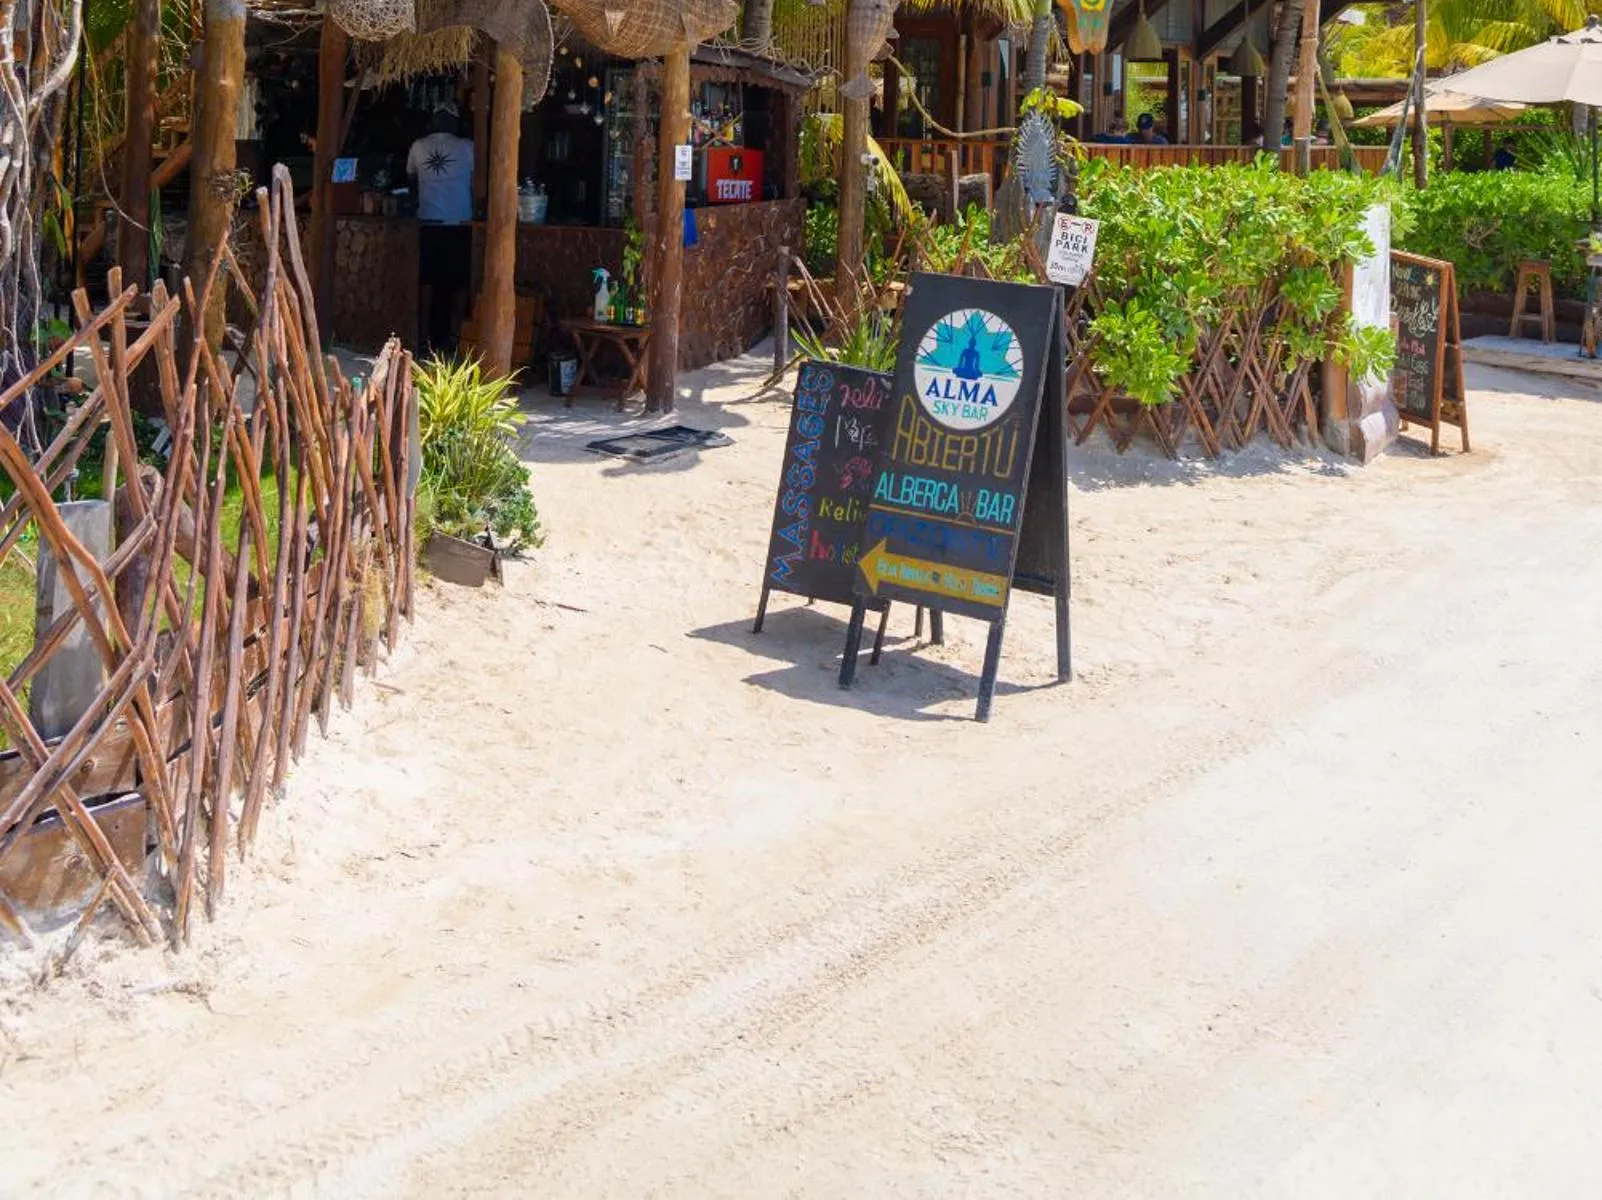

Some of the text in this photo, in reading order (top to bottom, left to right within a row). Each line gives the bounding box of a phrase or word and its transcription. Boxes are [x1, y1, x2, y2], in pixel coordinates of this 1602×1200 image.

[1055, 239, 1089, 254] PARK
[1060, 231, 1088, 244] BICI
[925, 376, 999, 407] ALMA
[933, 400, 989, 422] SKY BAR
[771, 365, 835, 584] MASSAGES
[874, 471, 961, 514] ALBERCA
[975, 488, 1017, 525] BAR
